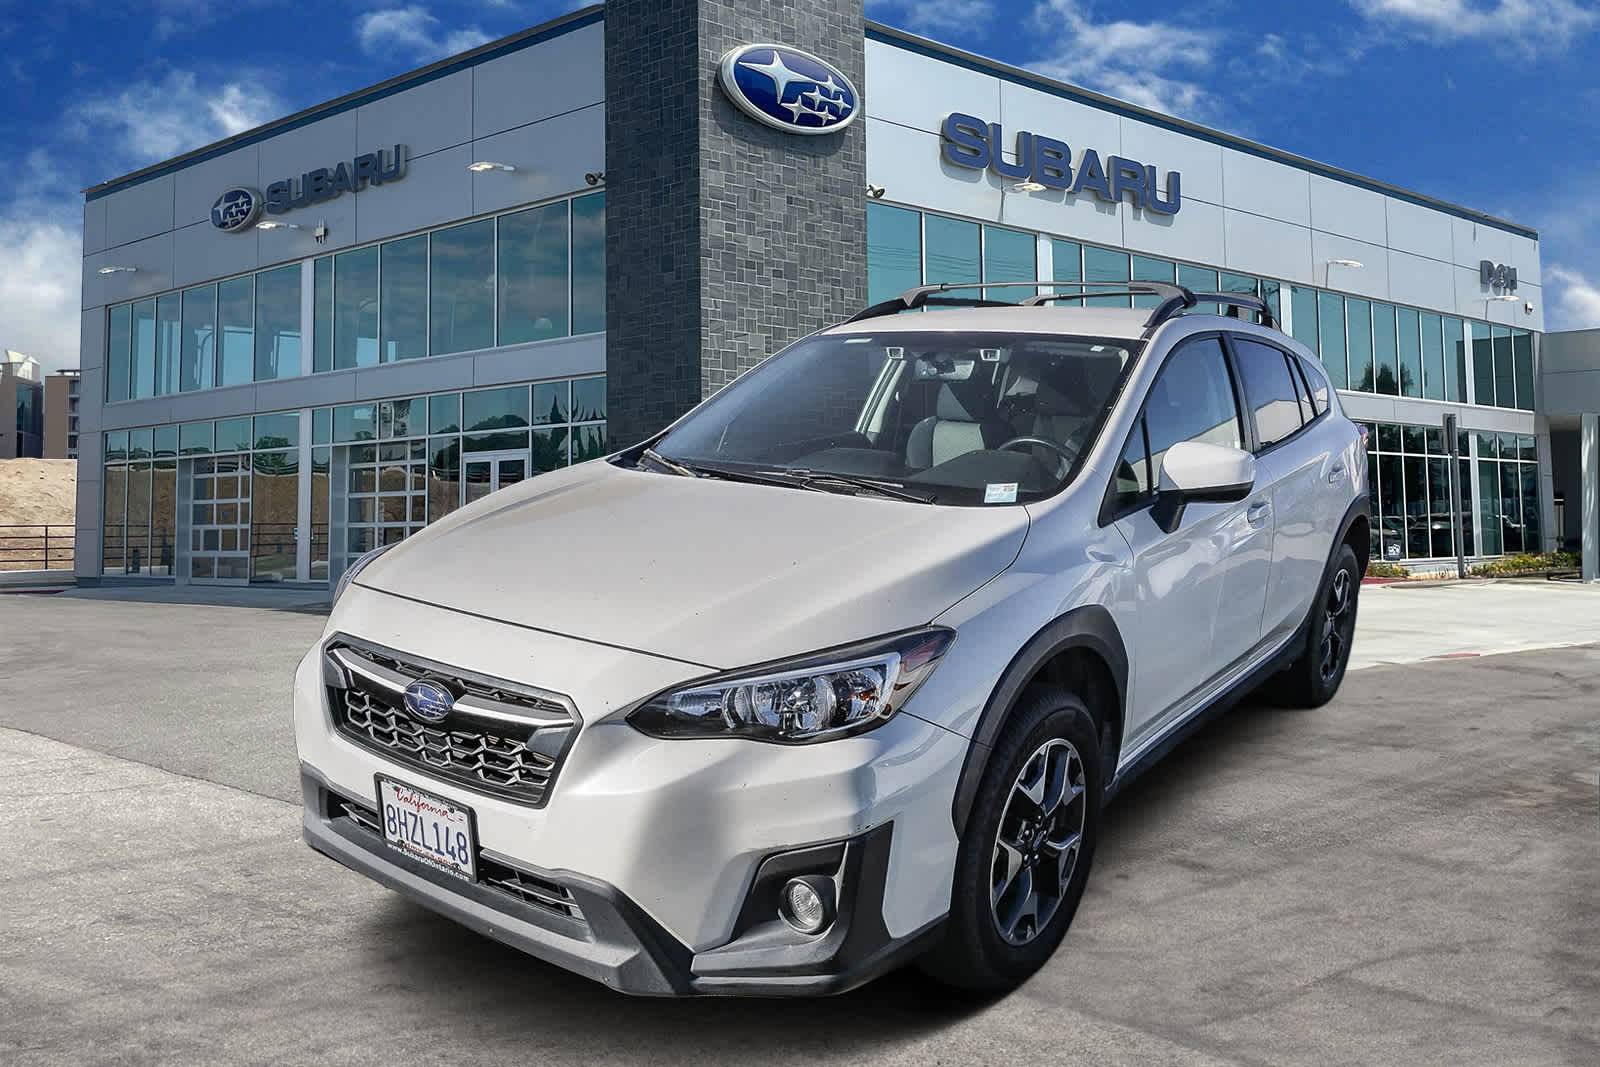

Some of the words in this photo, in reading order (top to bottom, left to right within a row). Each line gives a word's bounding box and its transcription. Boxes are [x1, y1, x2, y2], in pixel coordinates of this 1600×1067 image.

[266, 144, 407, 214] SUBARU
[941, 112, 1181, 215] SUBARU
[386, 804, 469, 865] 8HZL148
[396, 787, 453, 821] California
